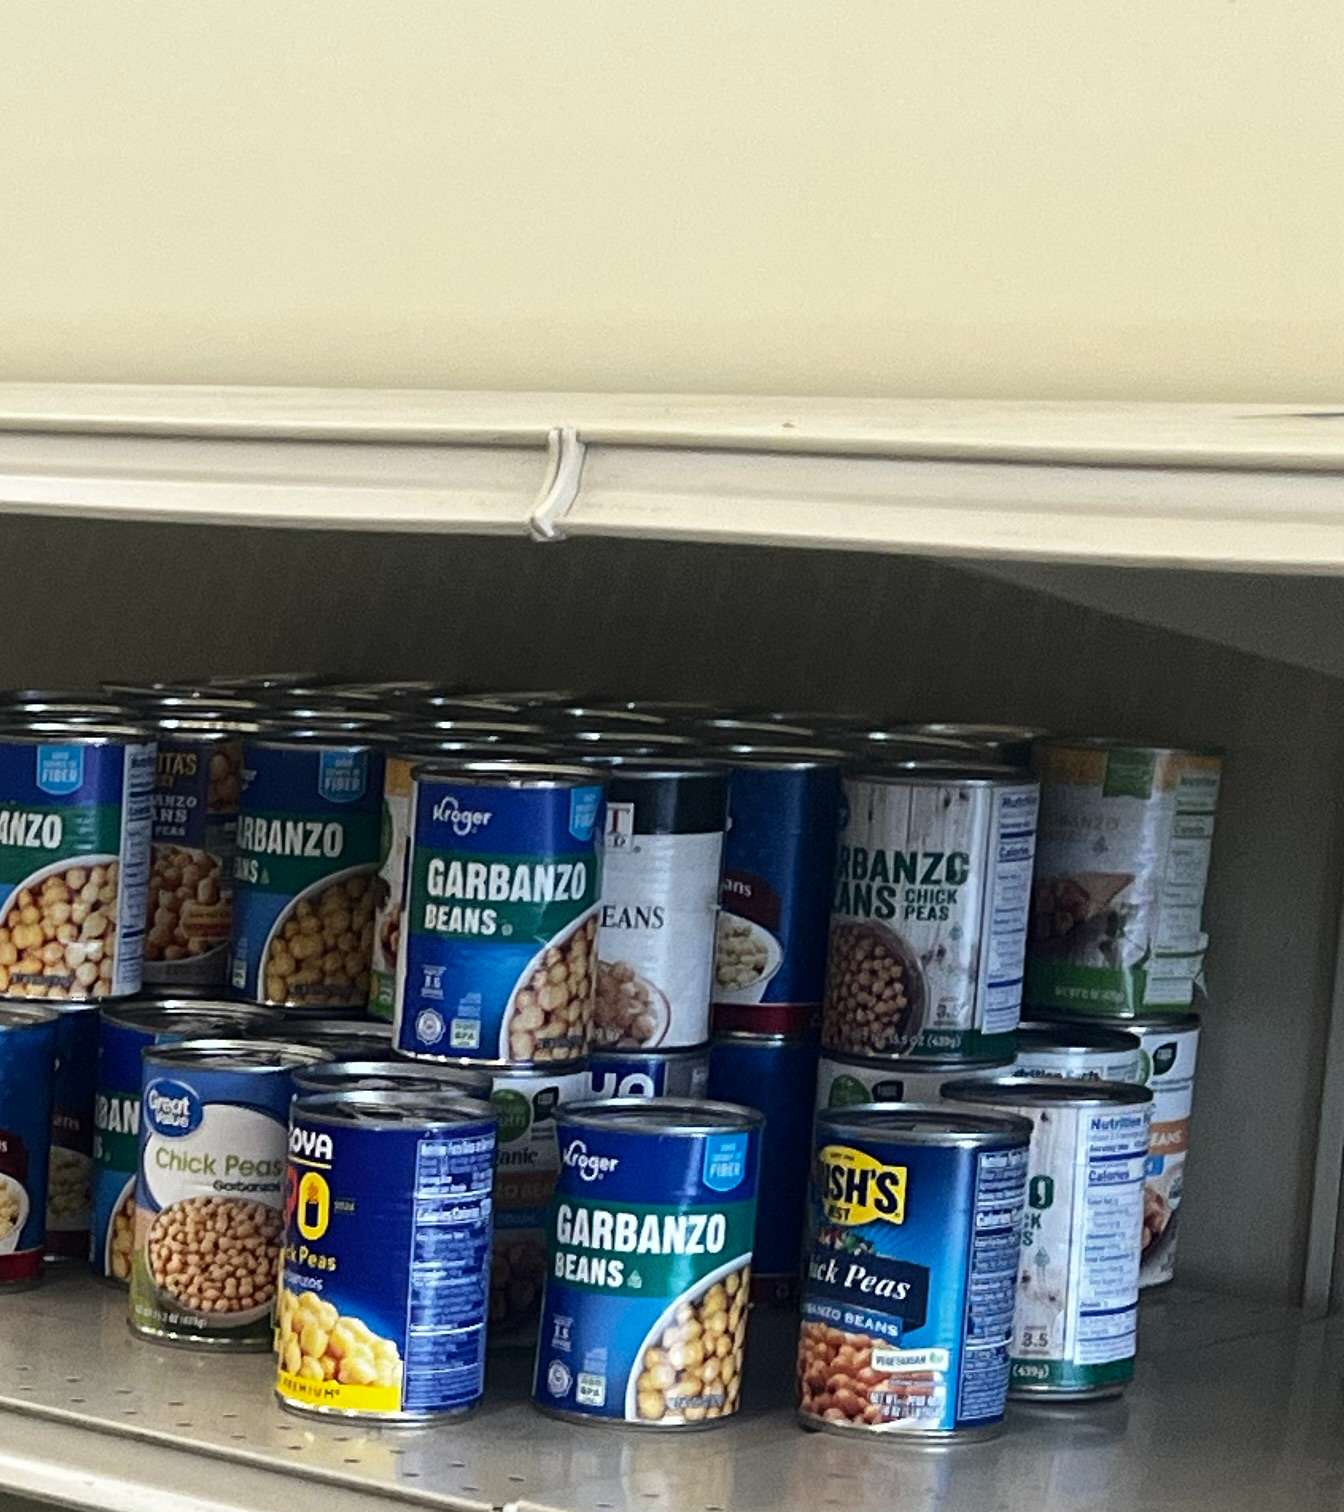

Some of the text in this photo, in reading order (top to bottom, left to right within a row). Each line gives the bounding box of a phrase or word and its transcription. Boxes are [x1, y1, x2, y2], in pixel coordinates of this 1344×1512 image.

[432, 796, 493, 837] Kroger
[426, 857, 588, 903] GARBANZO
[904, 888, 958, 905] CHICK
[423, 902, 499, 936] BEANS
[904, 905, 950, 921] PEAS
[148, 1088, 190, 1116] Great
[1090, 1117, 1142, 1131] Nutrition
[155, 1147, 284, 1178] Chick Peas
[563, 1139, 620, 1182] Kroger
[1088, 1170, 1130, 1183] Calories
[556, 1203, 727, 1255] GARBANZO
[300, 1245, 337, 1272] Peas
[554, 1252, 625, 1288] BEANS
[844, 1264, 912, 1301] Peas
[844, 1311, 900, 1337] BEANS
